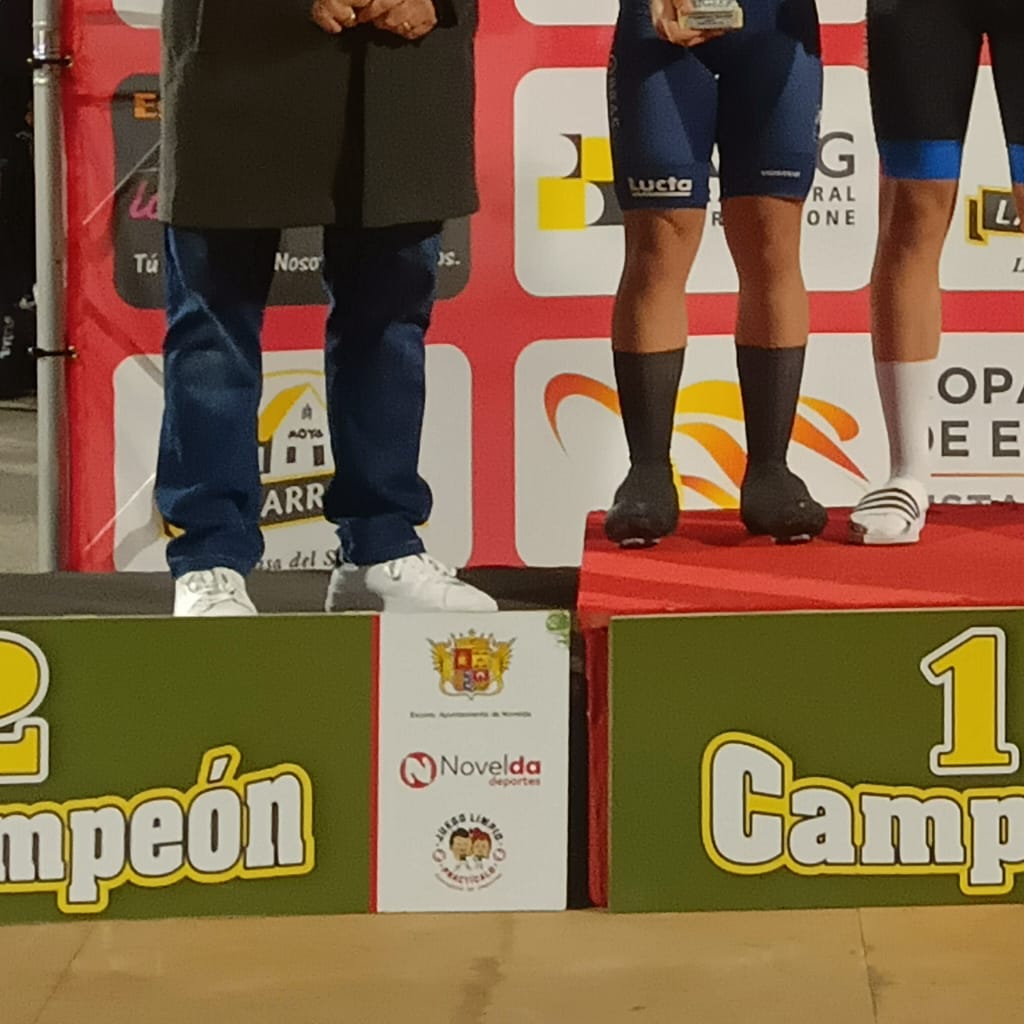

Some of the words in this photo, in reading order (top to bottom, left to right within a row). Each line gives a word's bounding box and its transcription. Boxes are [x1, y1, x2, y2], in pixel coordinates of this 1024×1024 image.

[134, 254, 160, 273] Tú
[928, 420, 969, 457] E
[920, 627, 1019, 775] 1
[440, 754, 541, 776] Novelda
[489, 777, 541, 787] deportes
[0, 750, 310, 908] mpeón
